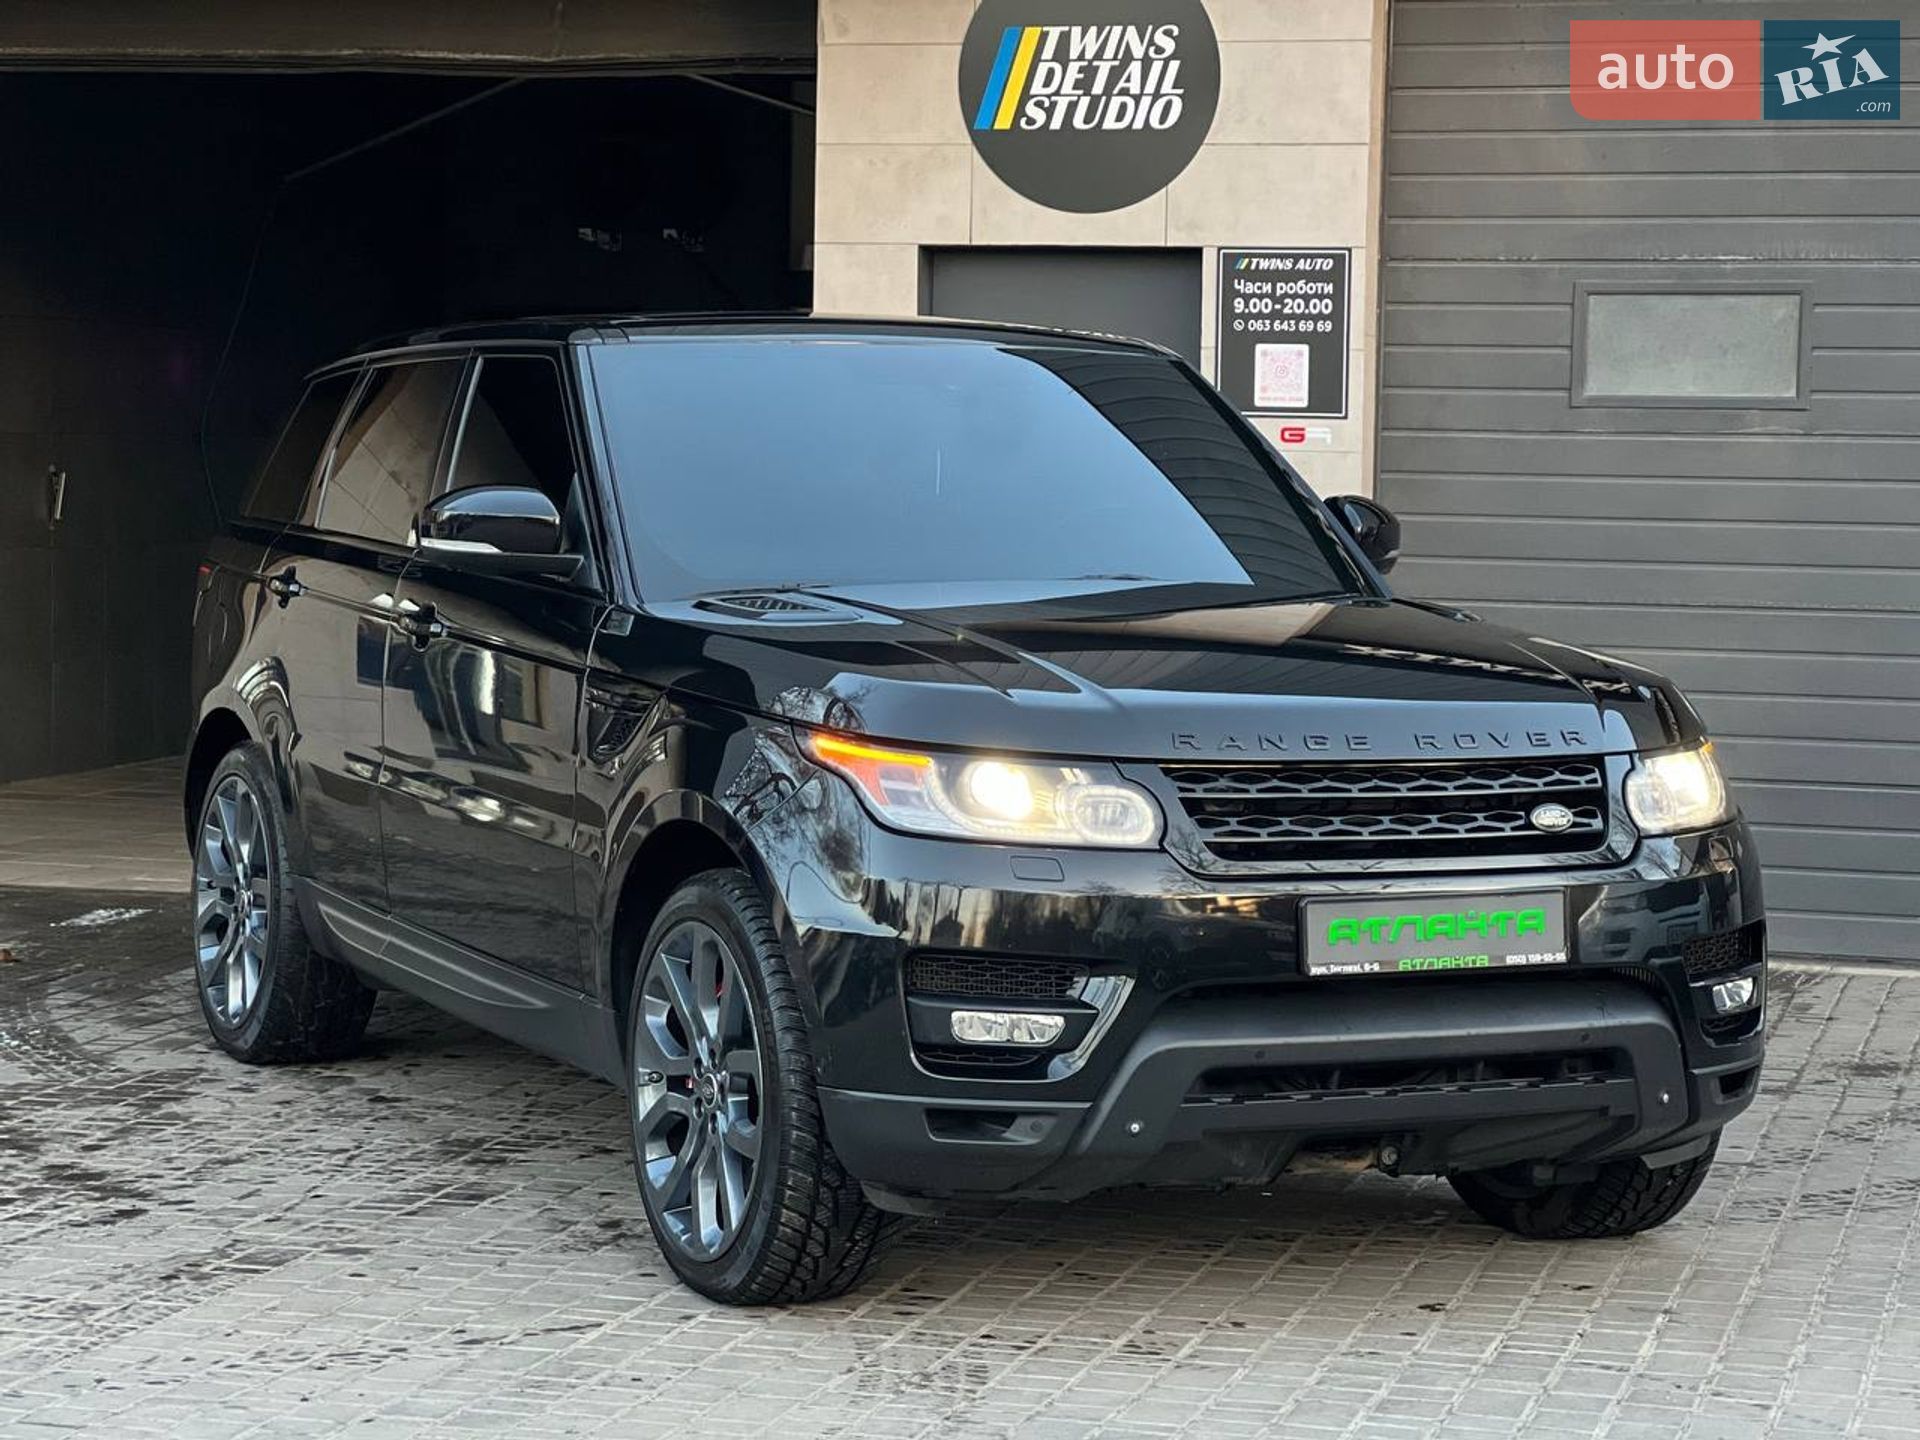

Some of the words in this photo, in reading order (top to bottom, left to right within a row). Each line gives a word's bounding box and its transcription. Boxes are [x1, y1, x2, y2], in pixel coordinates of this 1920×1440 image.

[1041, 24, 1179, 60] TWINS
[1029, 60, 1185, 95] DETAIL
[1019, 95, 1183, 130] STUDIO
[1250, 257, 1293, 271] TWINS
[1295, 257, 1334, 271] AUTO
[1233, 278, 1272, 294] Часи
[1275, 279, 1334, 297] роботи
[1247, 319, 1271, 332] 063
[1273, 319, 1296, 332] 643
[1299, 319, 1315, 333] 69
[1316, 319, 1333, 333] 69
[1171, 731, 1372, 751] RANGE
[1413, 729, 1588, 750] ROVER
